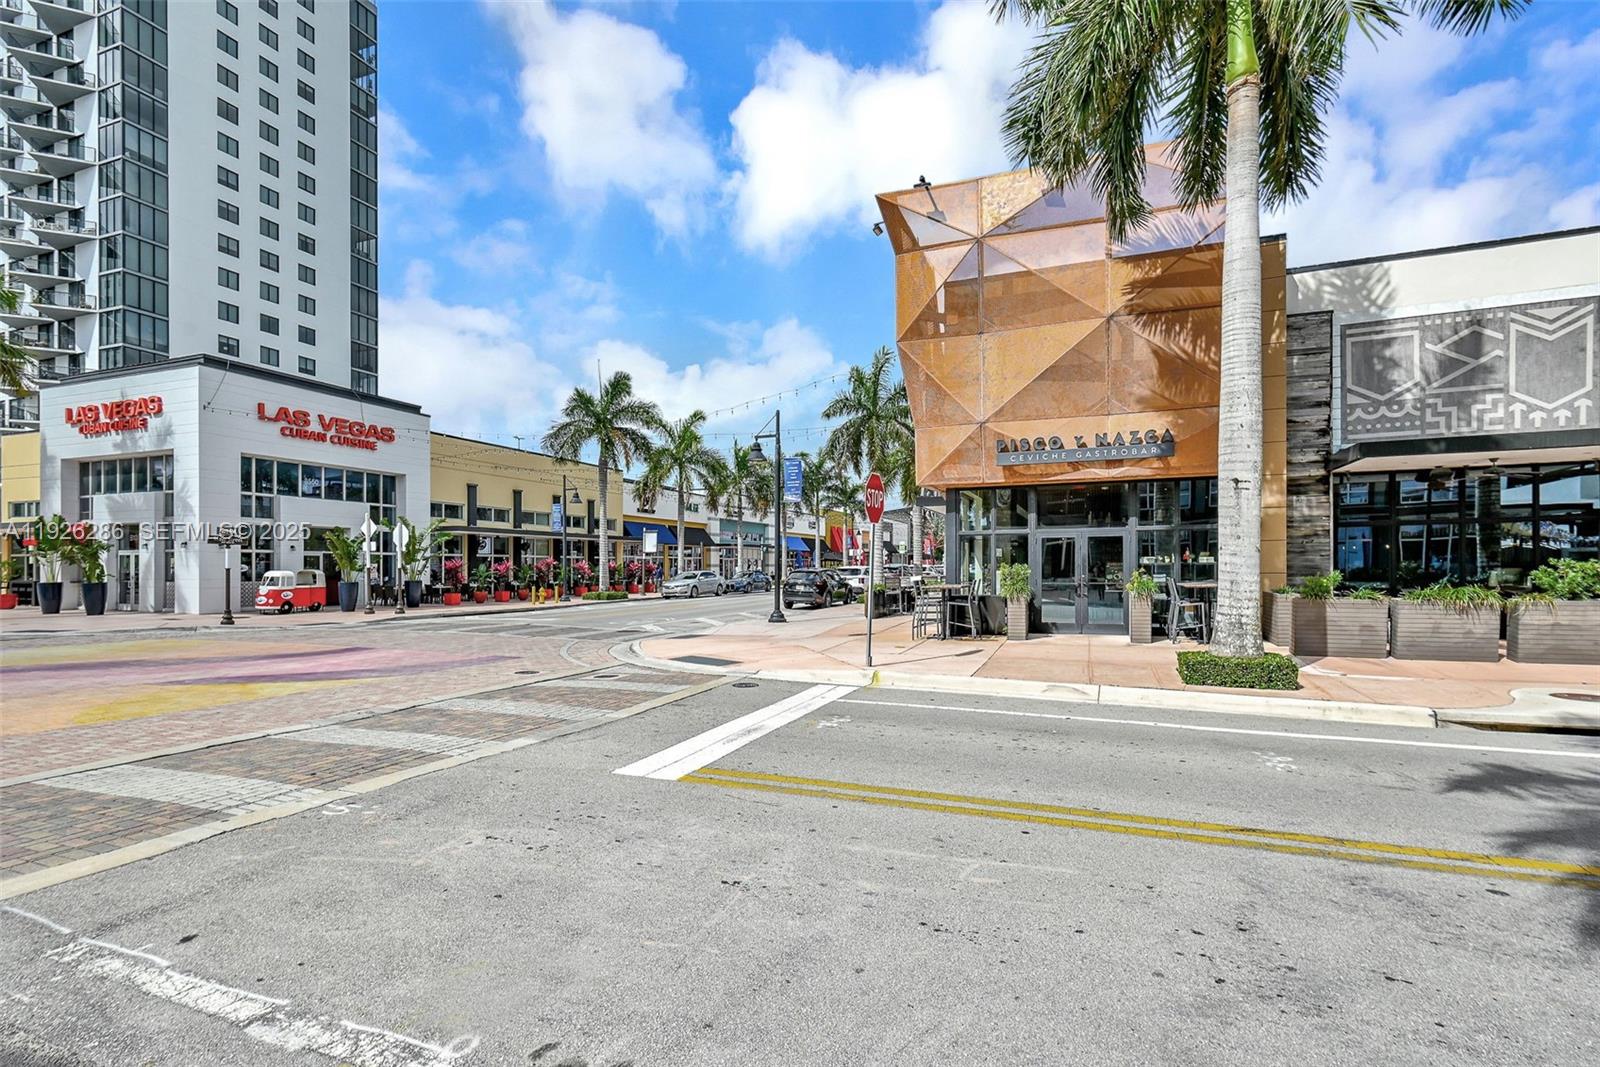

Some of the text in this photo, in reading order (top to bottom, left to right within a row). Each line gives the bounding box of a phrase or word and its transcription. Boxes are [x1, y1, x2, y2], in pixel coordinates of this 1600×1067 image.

[65, 396, 163, 425] LAS VEGAS
[257, 402, 395, 442] LAS VEGAS
[79, 417, 148, 434] CUBAN CUISINE
[280, 426, 378, 450] CUBAN CUISINE
[996, 427, 1175, 453] PISCO Y NAZCA
[1010, 446, 1157, 463] CEVICHE GASTROBAR
[867, 488, 884, 509] STOP
